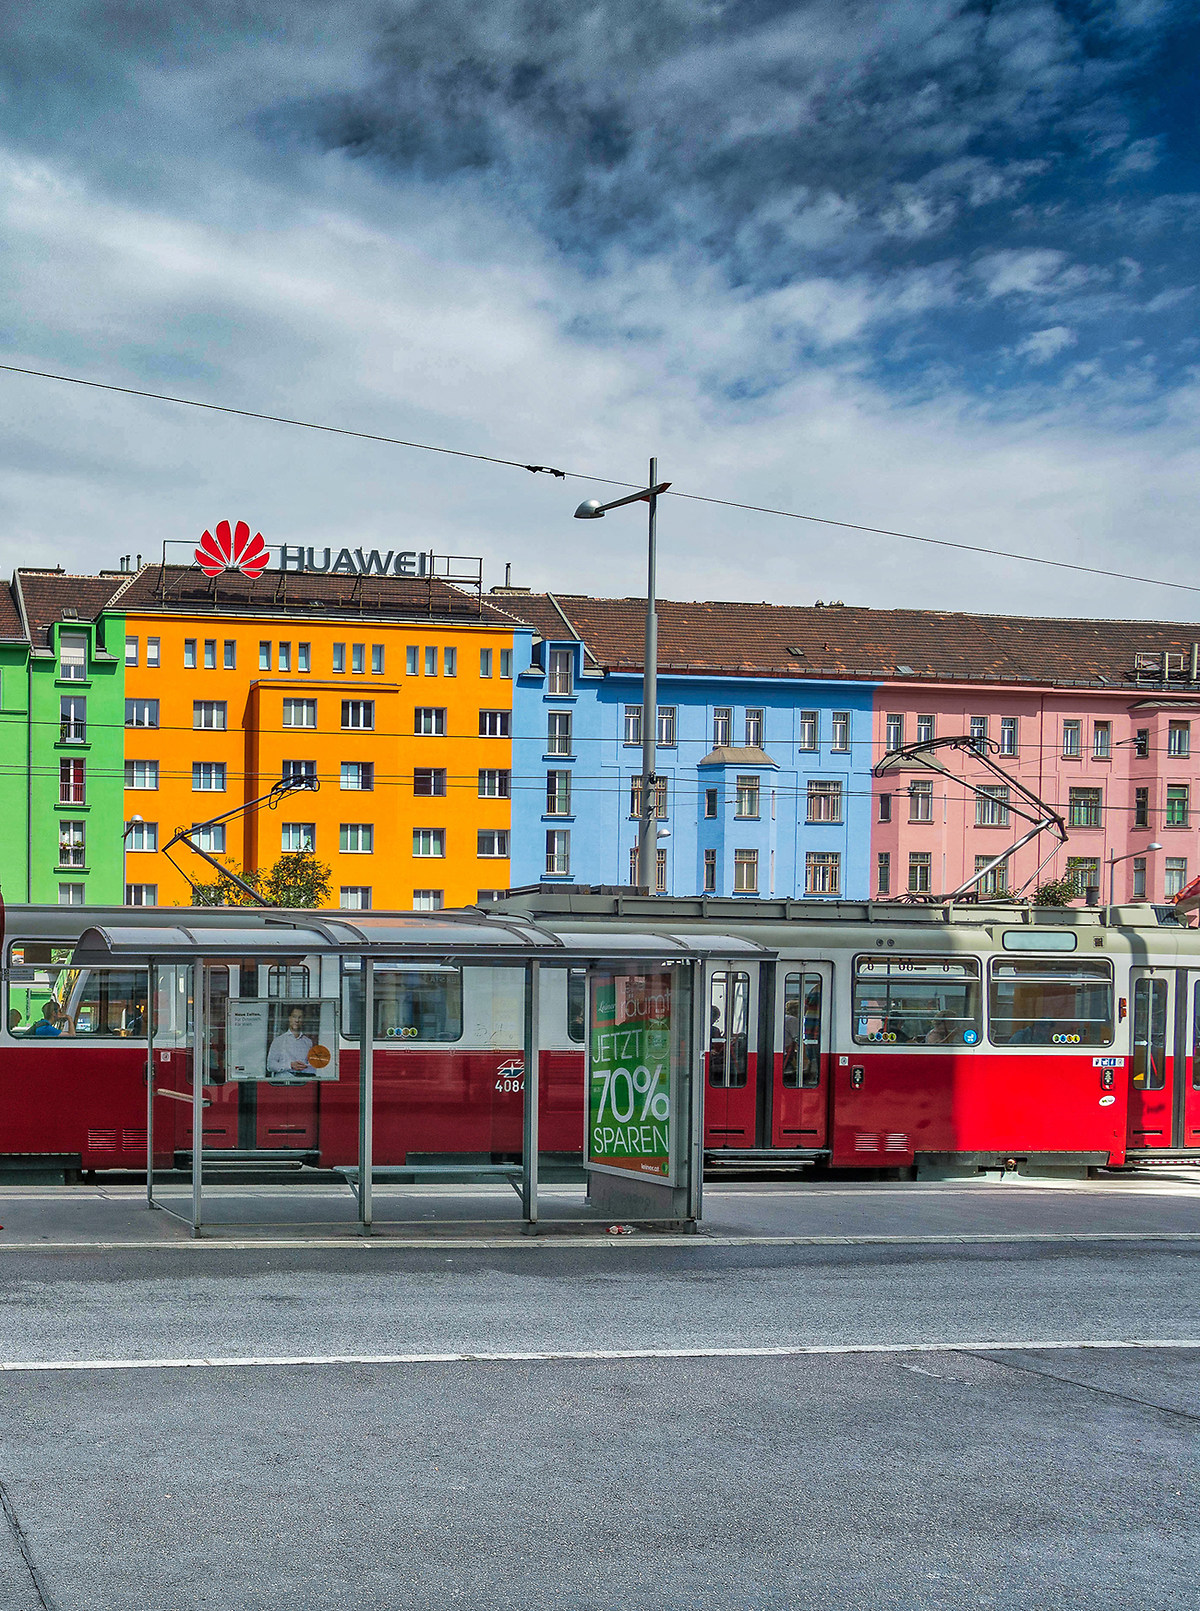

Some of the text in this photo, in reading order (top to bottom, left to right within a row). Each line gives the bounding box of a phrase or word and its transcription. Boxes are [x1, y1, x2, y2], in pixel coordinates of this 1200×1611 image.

[280, 545, 428, 578] HUAWEI
[592, 1029, 643, 1063] JETZT
[592, 1064, 670, 1124] 70%
[593, 1125, 670, 1154] SPAREN
